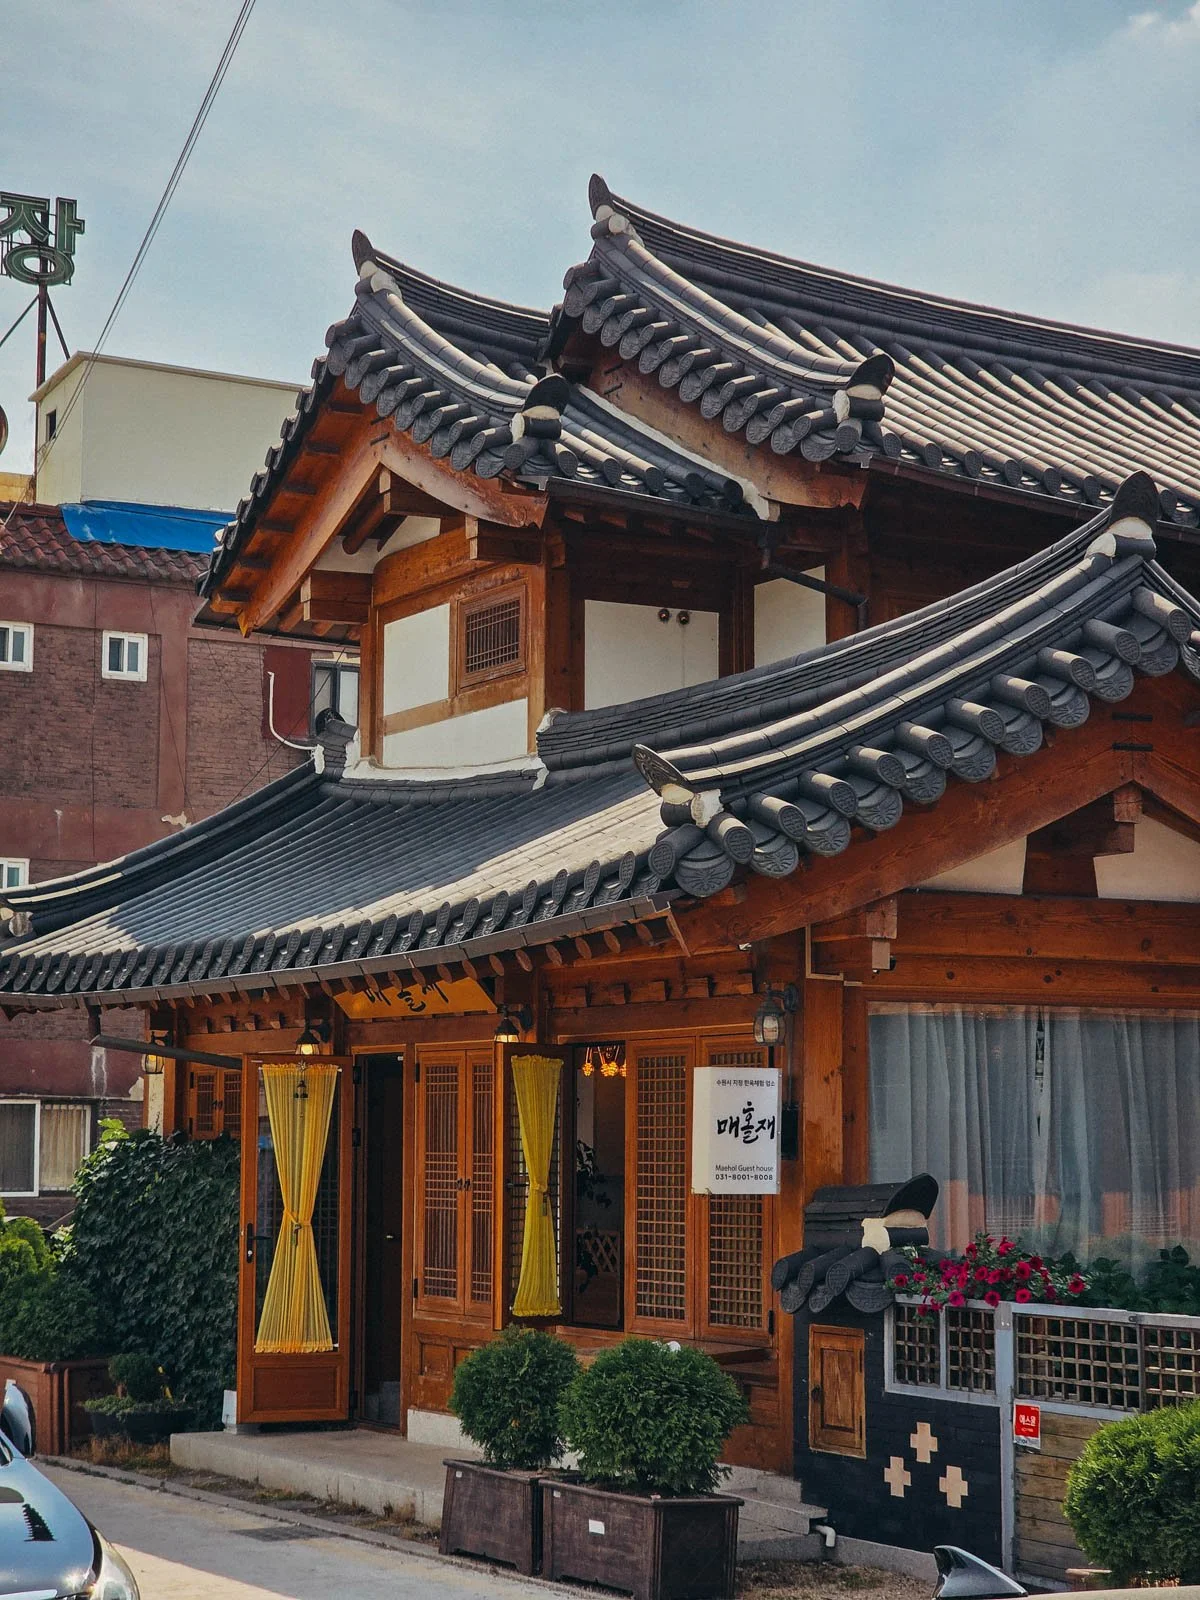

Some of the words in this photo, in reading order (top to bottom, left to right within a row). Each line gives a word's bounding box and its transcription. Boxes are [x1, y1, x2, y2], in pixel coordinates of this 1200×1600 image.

[0, 191, 85, 286] 장
[717, 1101, 776, 1144] 매홀재
[715, 1164, 737, 1172] Maehol
[738, 1164, 755, 1172] Guest
[756, 1164, 774, 1172] house
